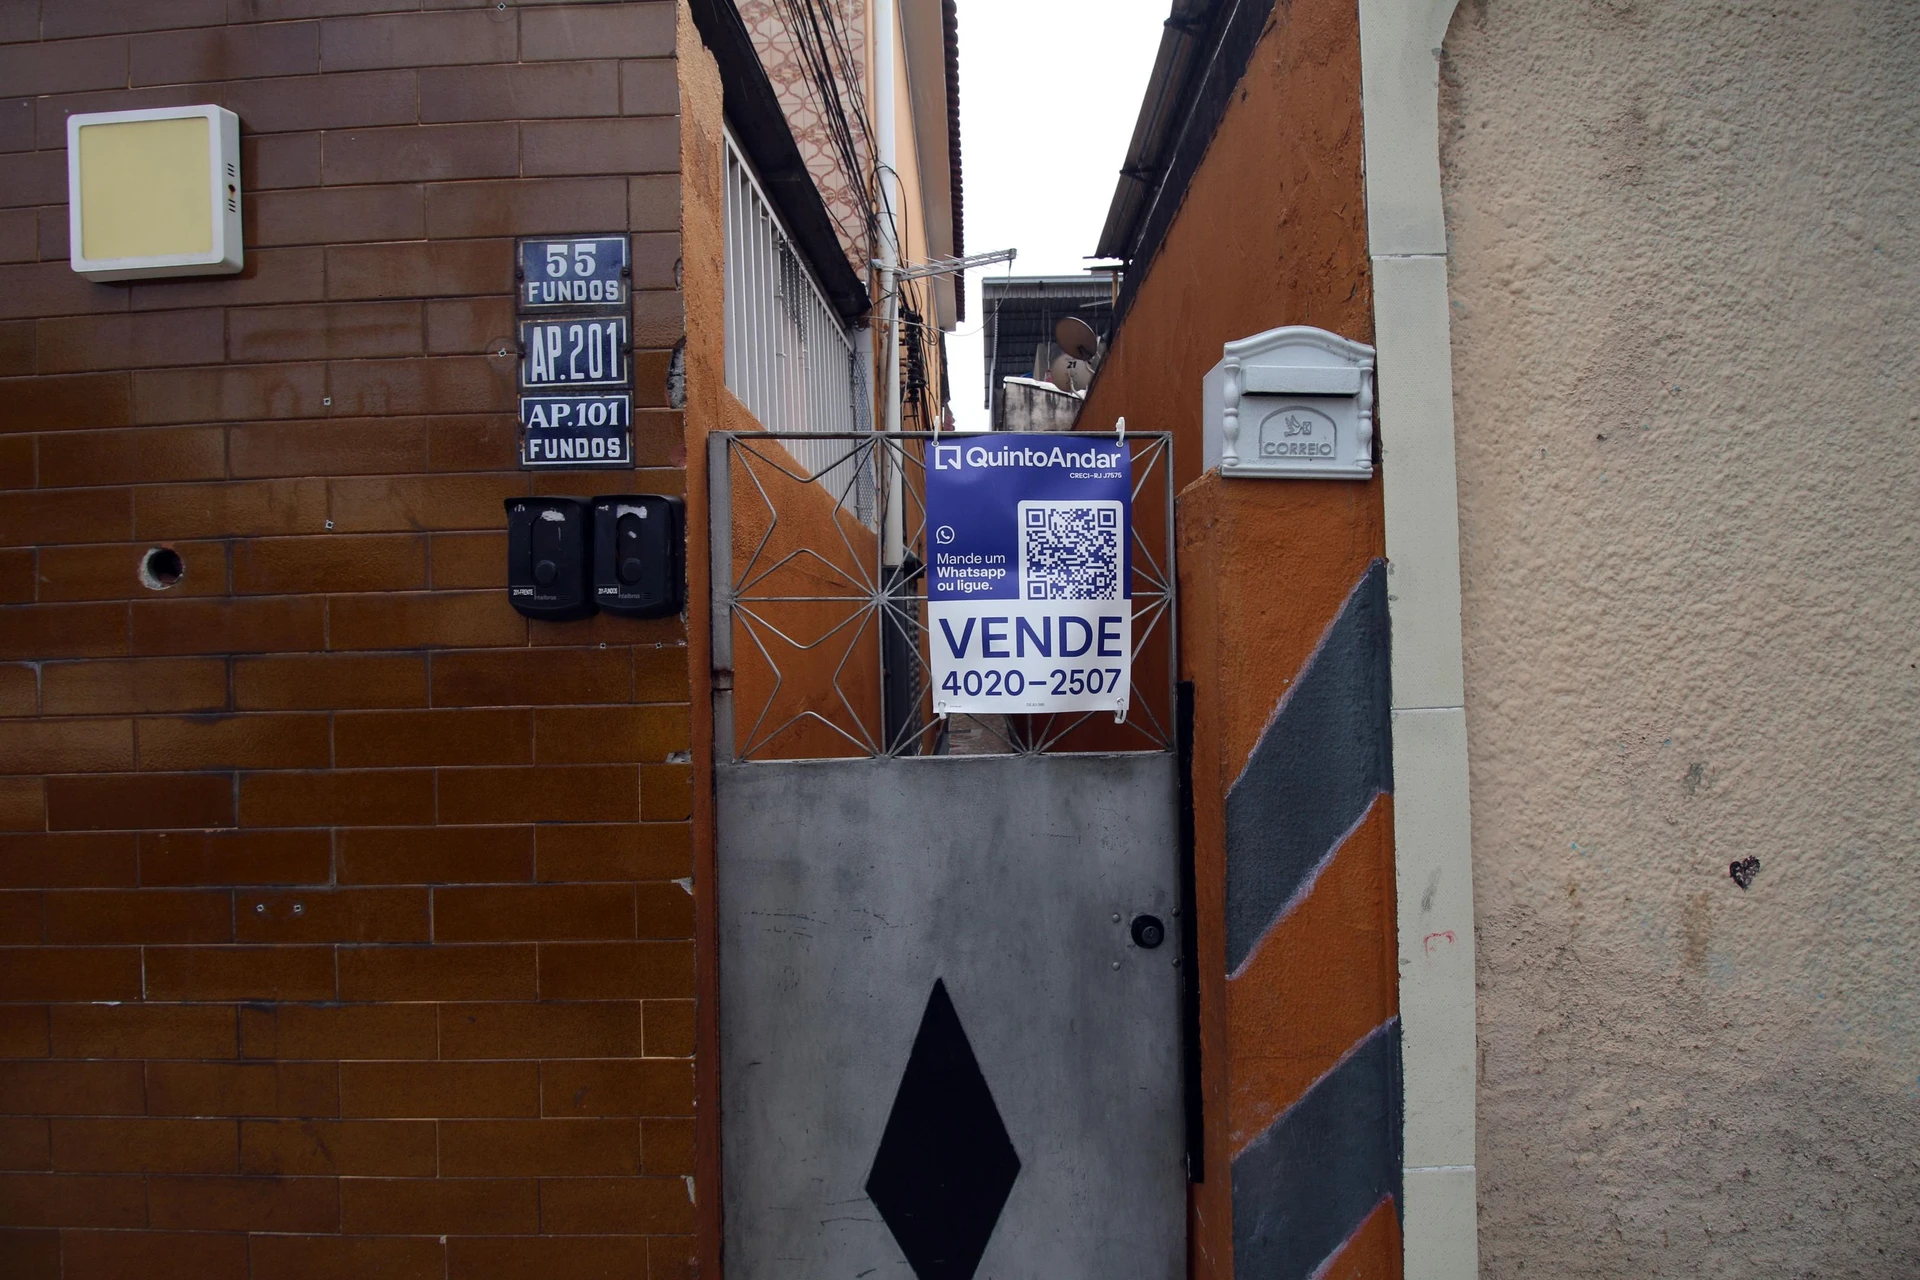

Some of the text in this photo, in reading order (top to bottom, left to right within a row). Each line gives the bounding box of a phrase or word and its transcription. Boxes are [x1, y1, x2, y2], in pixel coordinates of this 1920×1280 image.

[546, 243, 597, 277] 55
[528, 280, 619, 303] FUNDOS
[531, 322, 618, 382] AP.201
[1067, 361, 1077, 369] 21
[527, 402, 619, 429] AP.101
[530, 438, 620, 459] FUNDOS
[966, 446, 1121, 468] QuintoAndar
[1264, 442, 1332, 455] CORREIO
[937, 553, 1006, 564] Mande um
[937, 566, 1006, 579] Whatsapp
[937, 580, 993, 594] ou ligue.
[939, 616, 1123, 659] VENDE
[941, 668, 1122, 697] 4020-2507
